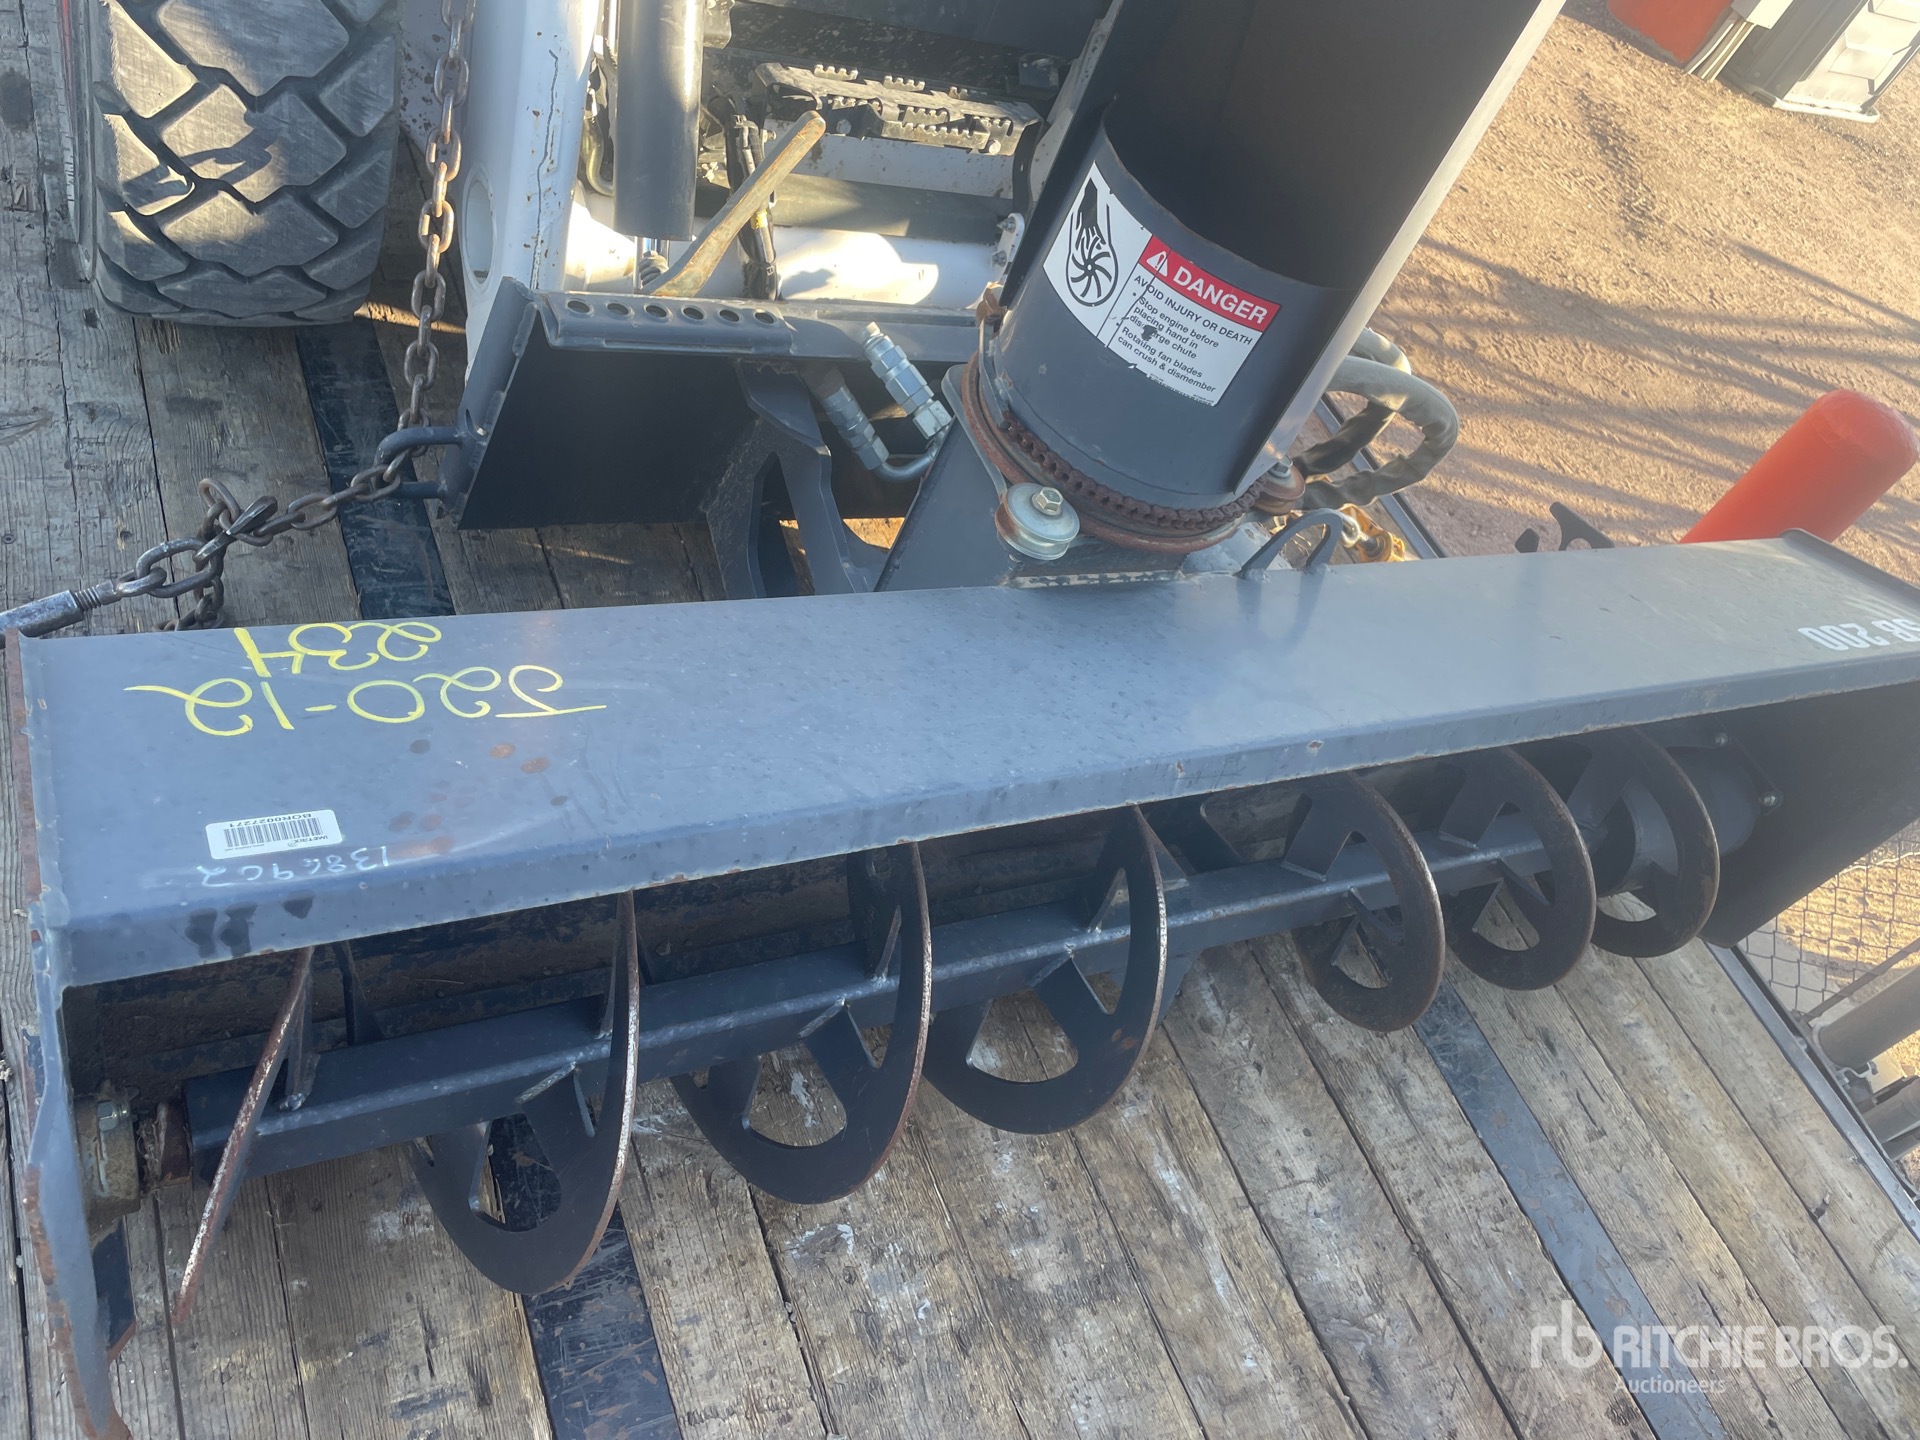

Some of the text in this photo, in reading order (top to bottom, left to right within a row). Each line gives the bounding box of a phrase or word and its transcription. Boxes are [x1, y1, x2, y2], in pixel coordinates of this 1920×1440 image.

[1134, 275, 1253, 345] AVOID INJURY OR DEATH
[1173, 266, 1268, 324] DANGER
[1129, 315, 1197, 359] disarge chute
[1133, 307, 1198, 349] placing hand in
[1139, 296, 1219, 348] Stop engine before
[1117, 336, 1133, 350] can
[1134, 348, 1158, 366] crush
[1159, 362, 1166, 371] &
[1167, 368, 1216, 392] dismember
[1122, 327, 1157, 355] Rotating
[1157, 351, 1172, 363] fan
[1173, 359, 1203, 378] blades
[1798, 623, 1890, 650] 200
[229, 813, 312, 828] BOR0027271
